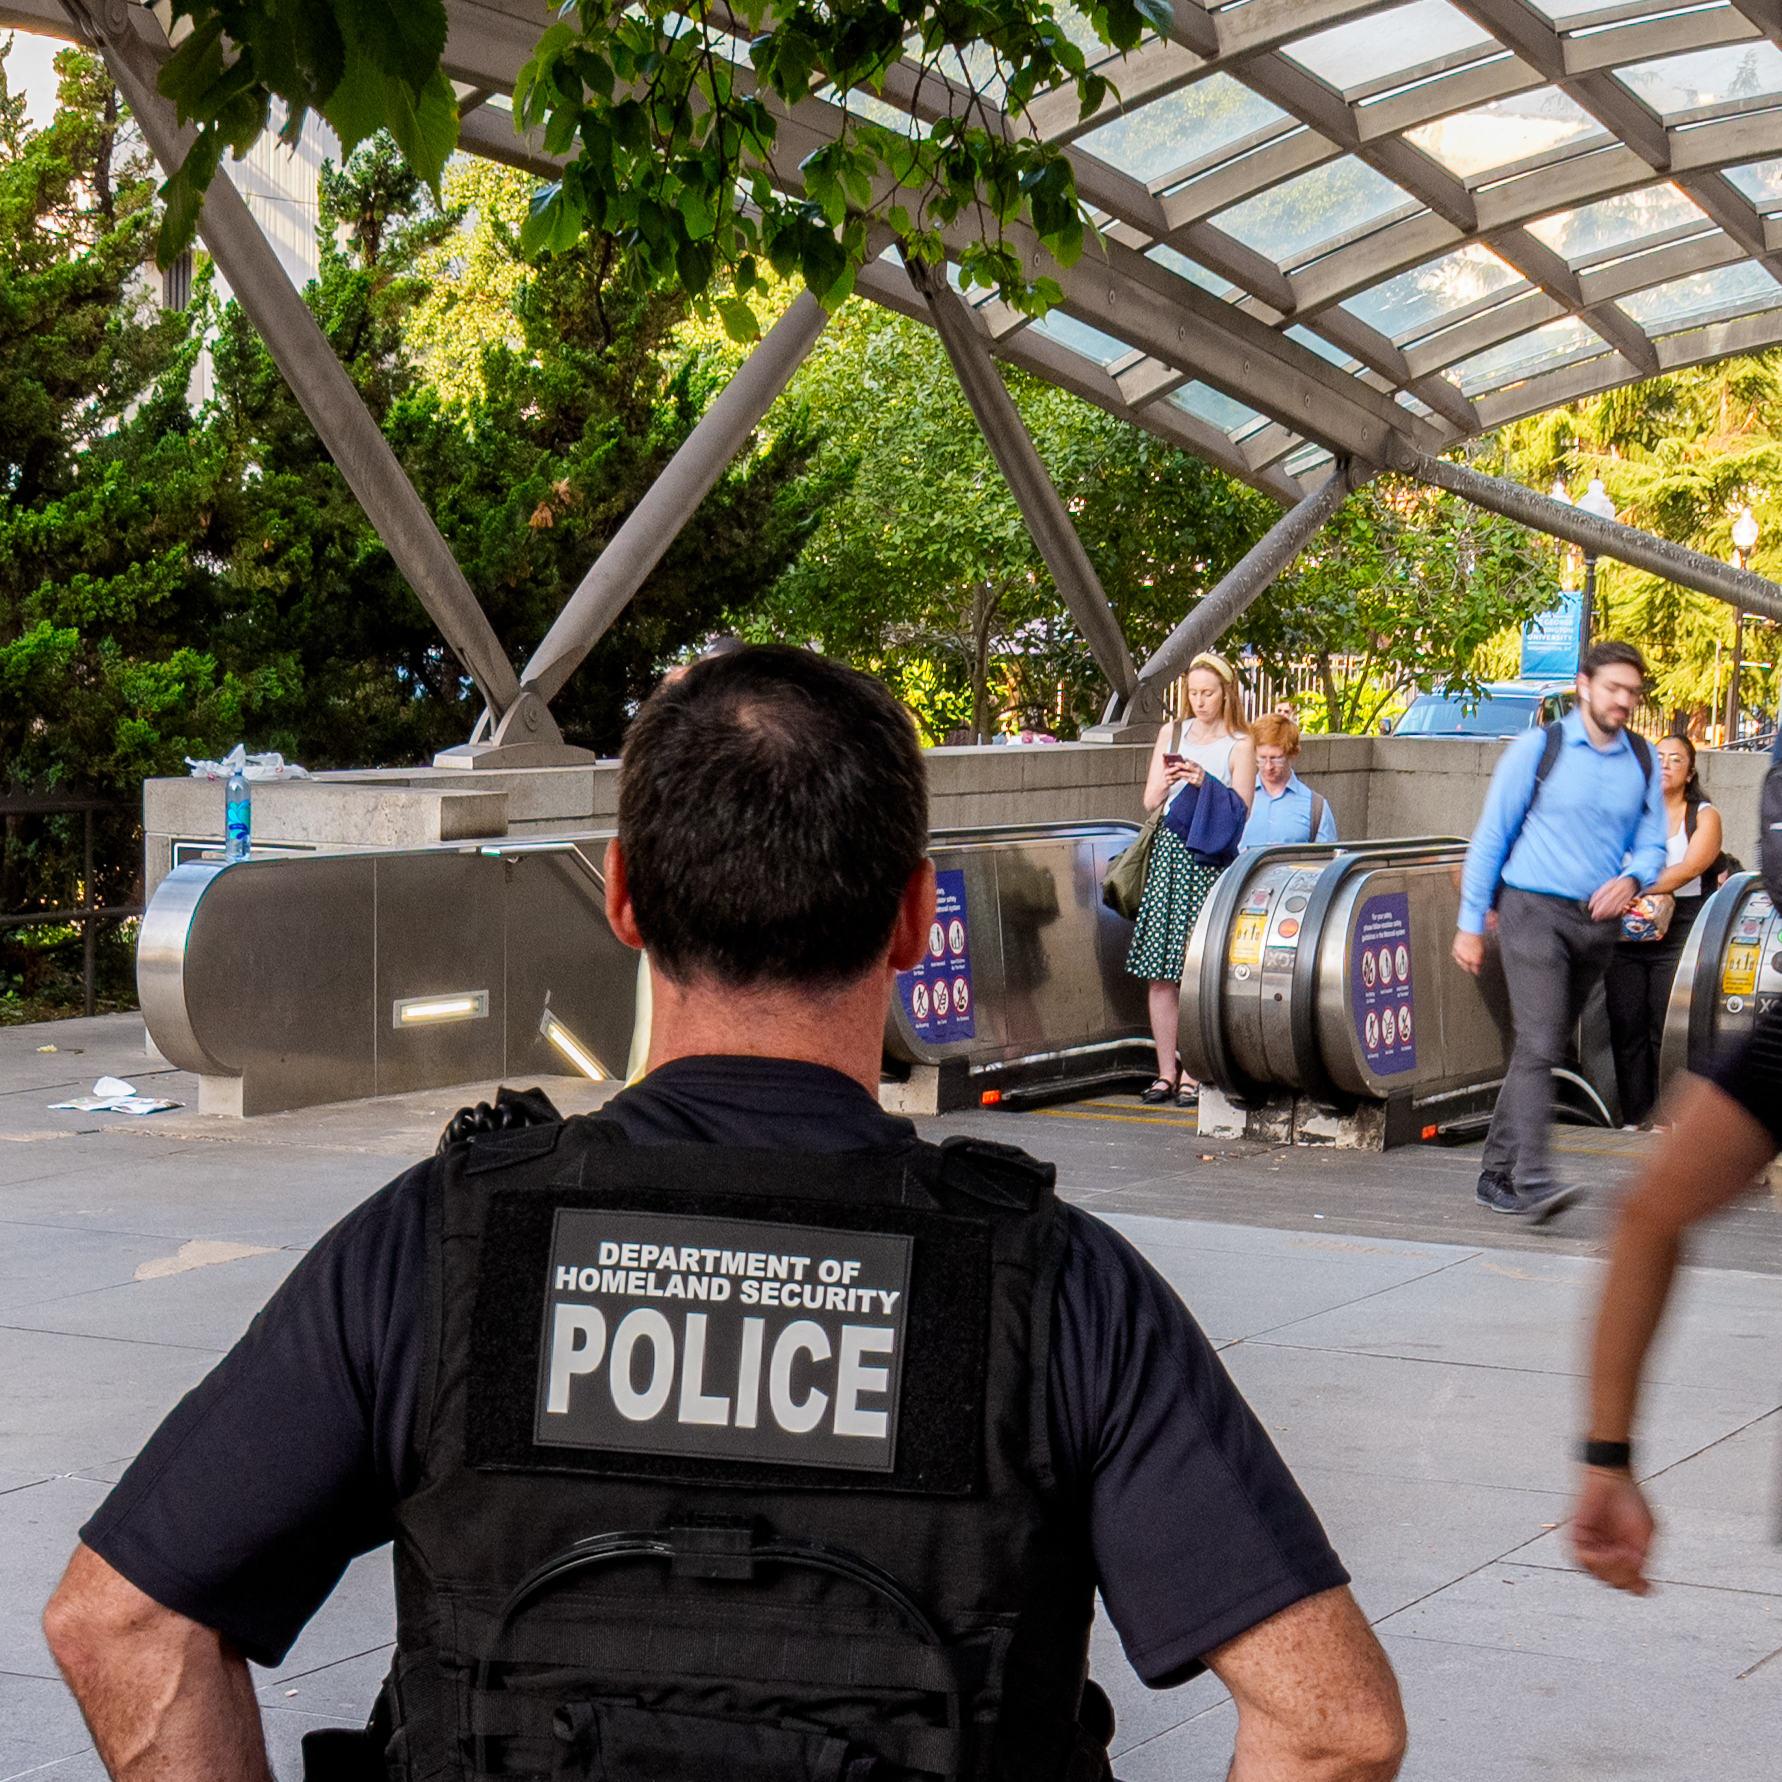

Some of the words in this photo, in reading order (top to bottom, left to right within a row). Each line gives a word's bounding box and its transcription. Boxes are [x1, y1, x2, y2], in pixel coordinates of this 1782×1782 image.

[598, 1241, 811, 1281] DEPARTMENT
[818, 1259, 861, 1285] OF
[554, 1265, 731, 1301] HOMELAND
[739, 1279, 900, 1315] SECURITY
[546, 1302, 895, 1438] POLICE
